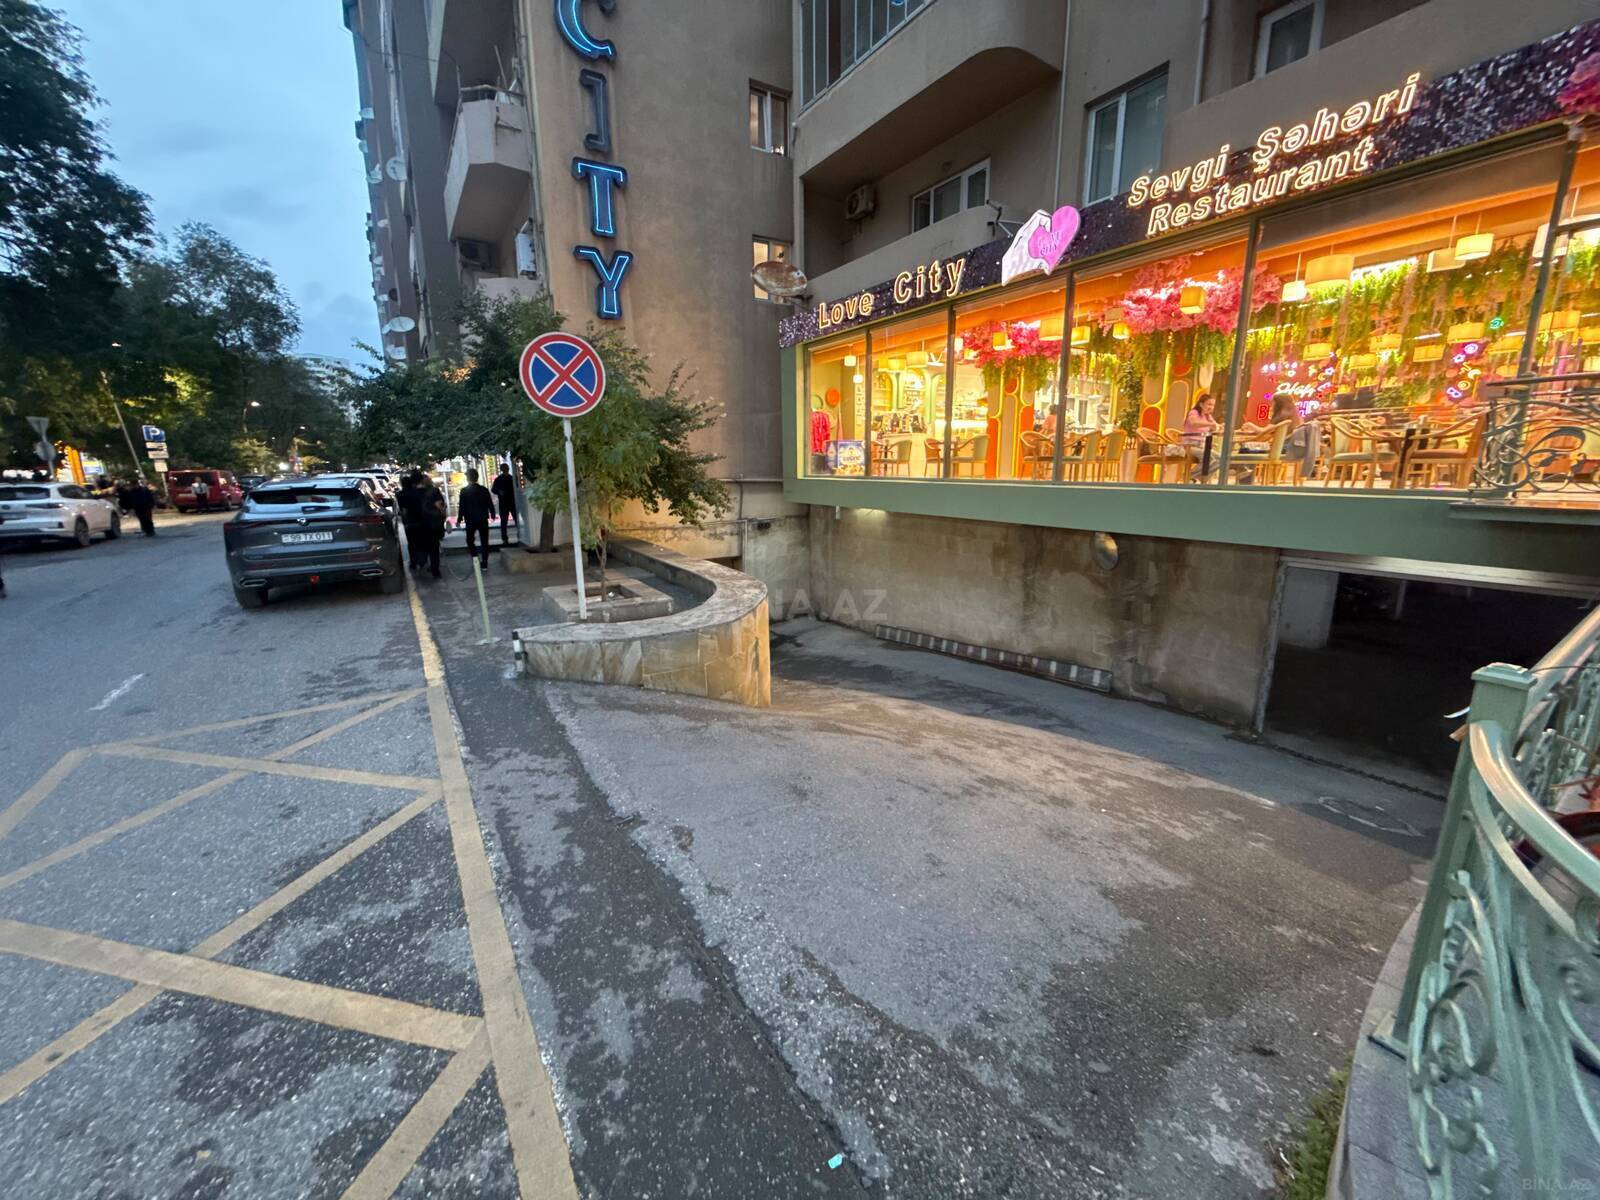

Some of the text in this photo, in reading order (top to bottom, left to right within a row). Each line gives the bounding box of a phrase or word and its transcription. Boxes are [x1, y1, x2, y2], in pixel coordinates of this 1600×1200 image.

[1128, 73, 1420, 206] Sevgi Şəhəri
[1146, 137, 1374, 236] Restaurant
[818, 257, 965, 328] Love City
